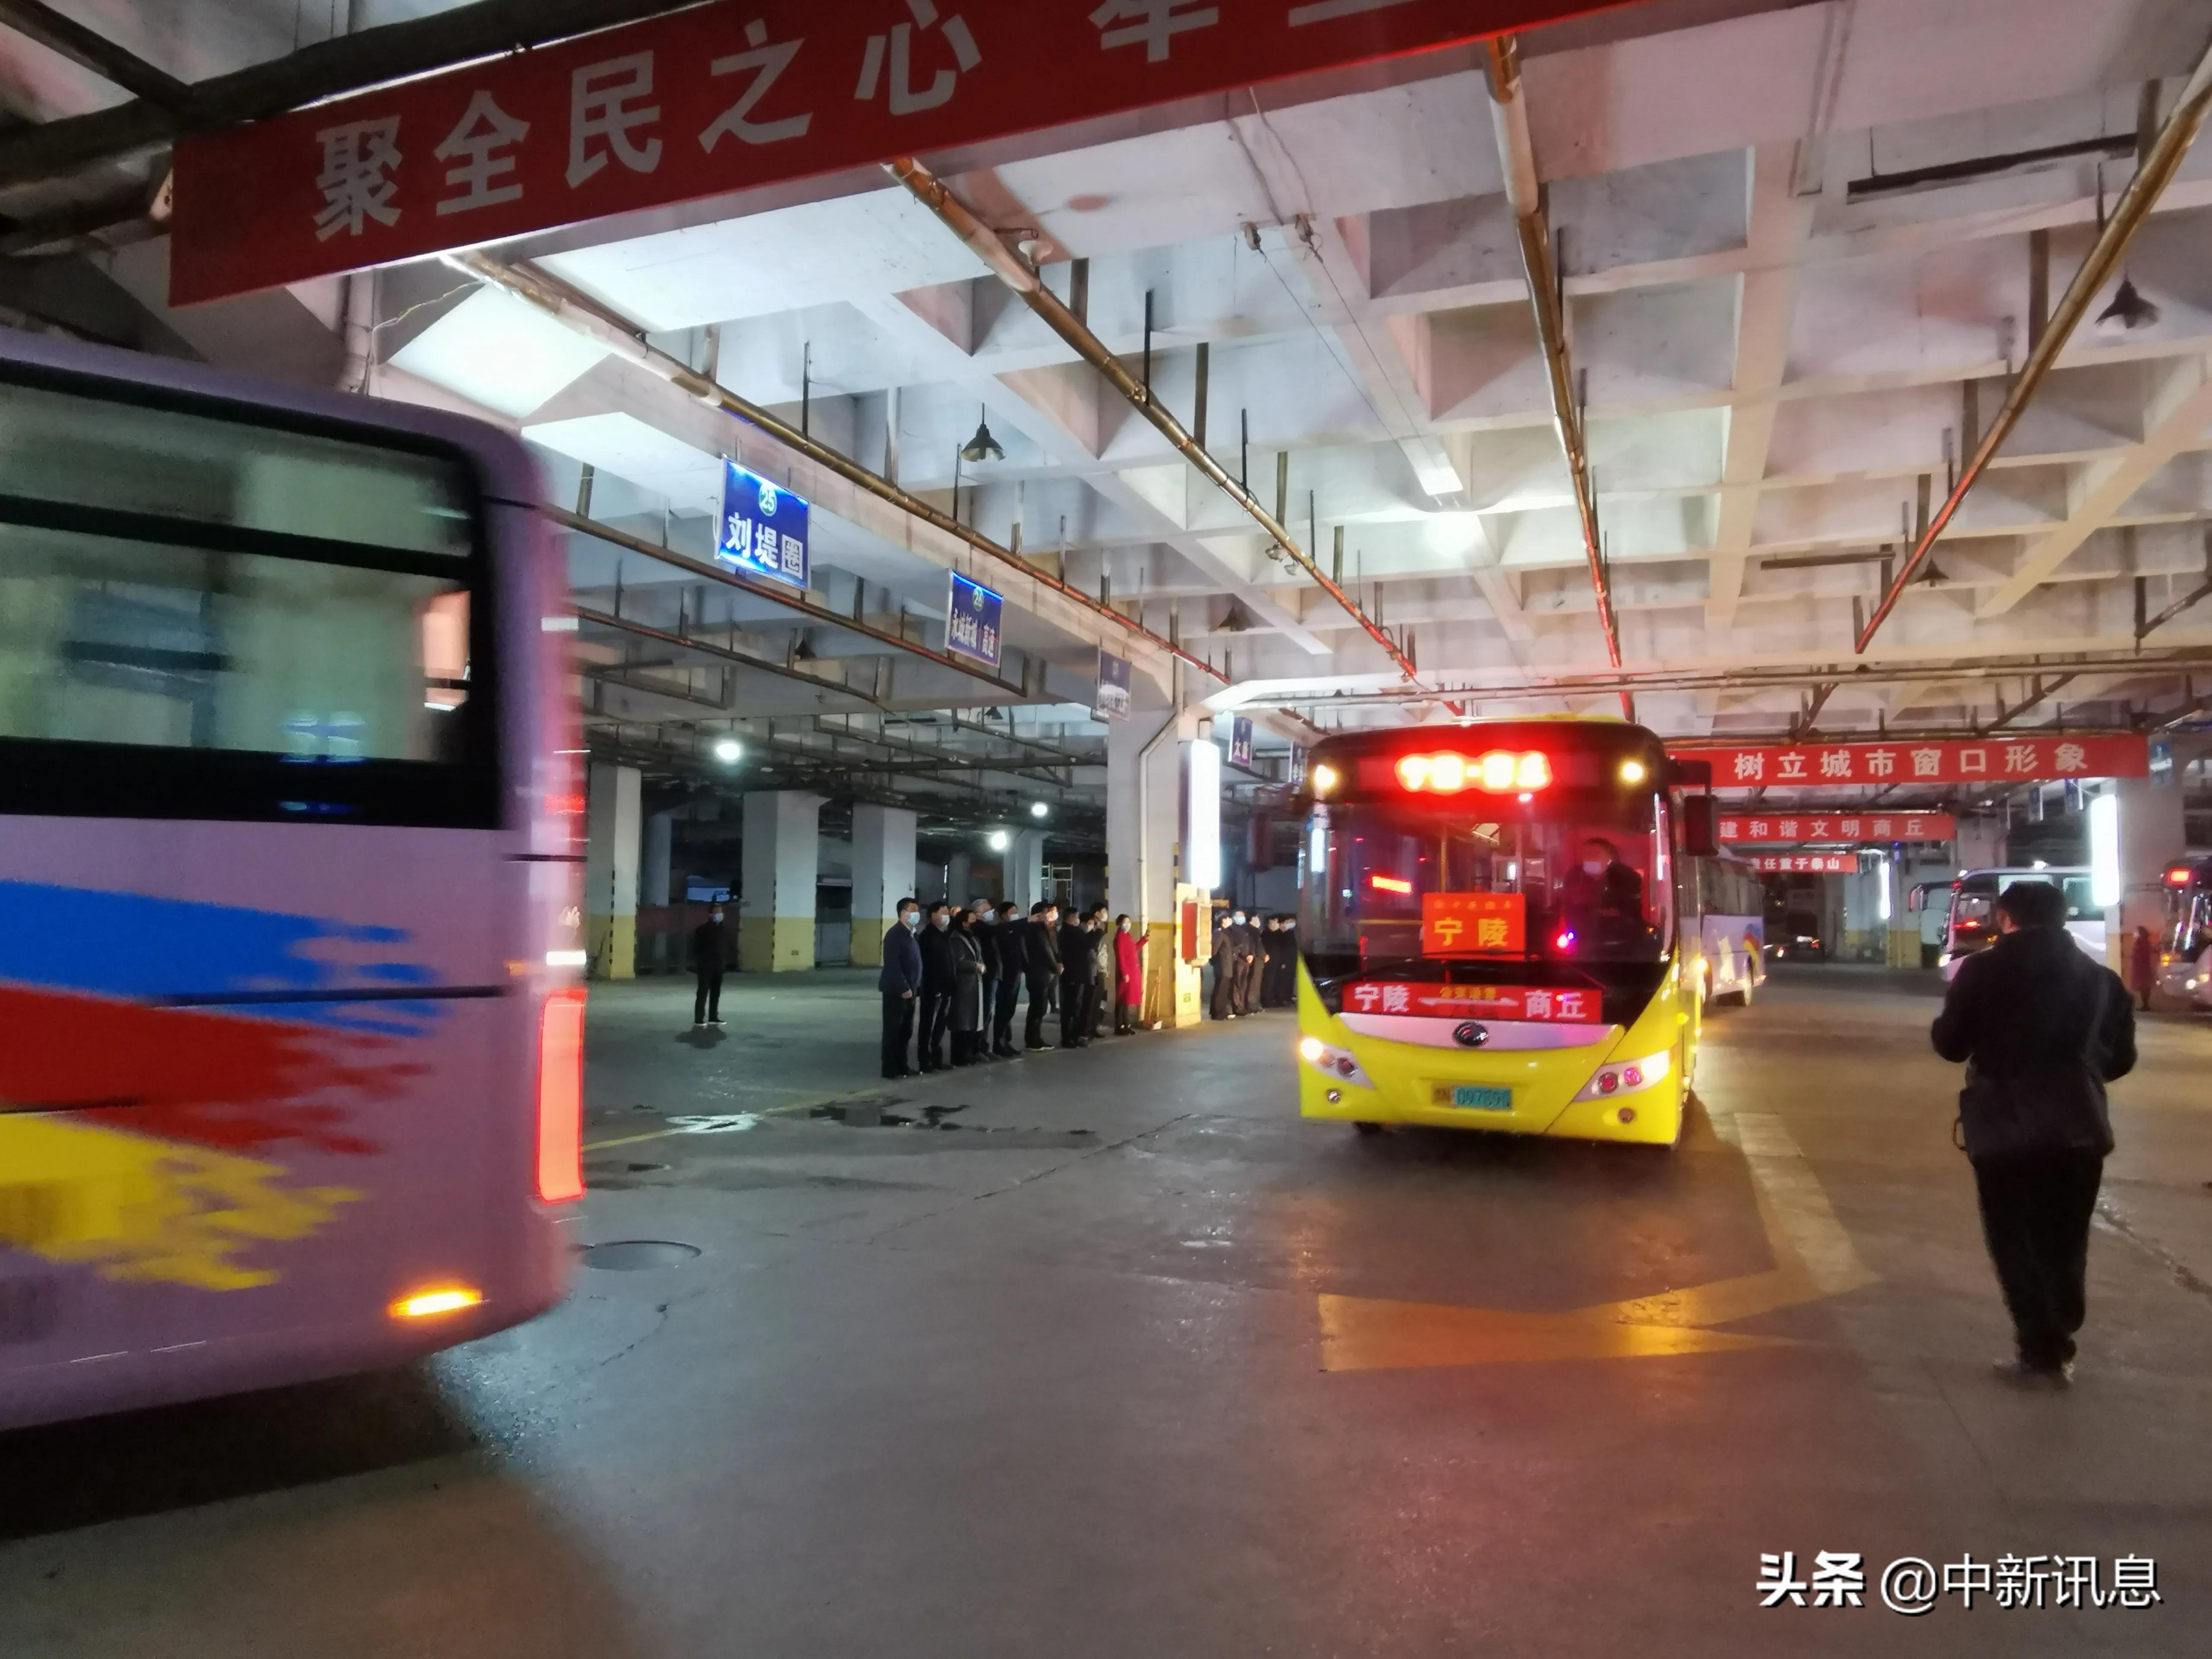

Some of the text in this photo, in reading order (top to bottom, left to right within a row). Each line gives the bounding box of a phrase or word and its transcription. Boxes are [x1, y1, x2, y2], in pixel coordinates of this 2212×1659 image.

[313, 0, 982, 242] 聚全民之心
[761, 488, 775, 512] 25
[1734, 743, 2088, 780] 树立城市窗口形象
[1434, 916, 1509, 947] 宁陵
[1354, 984, 1411, 1013] 宁陵
[1525, 989, 1586, 1018] 商丘
